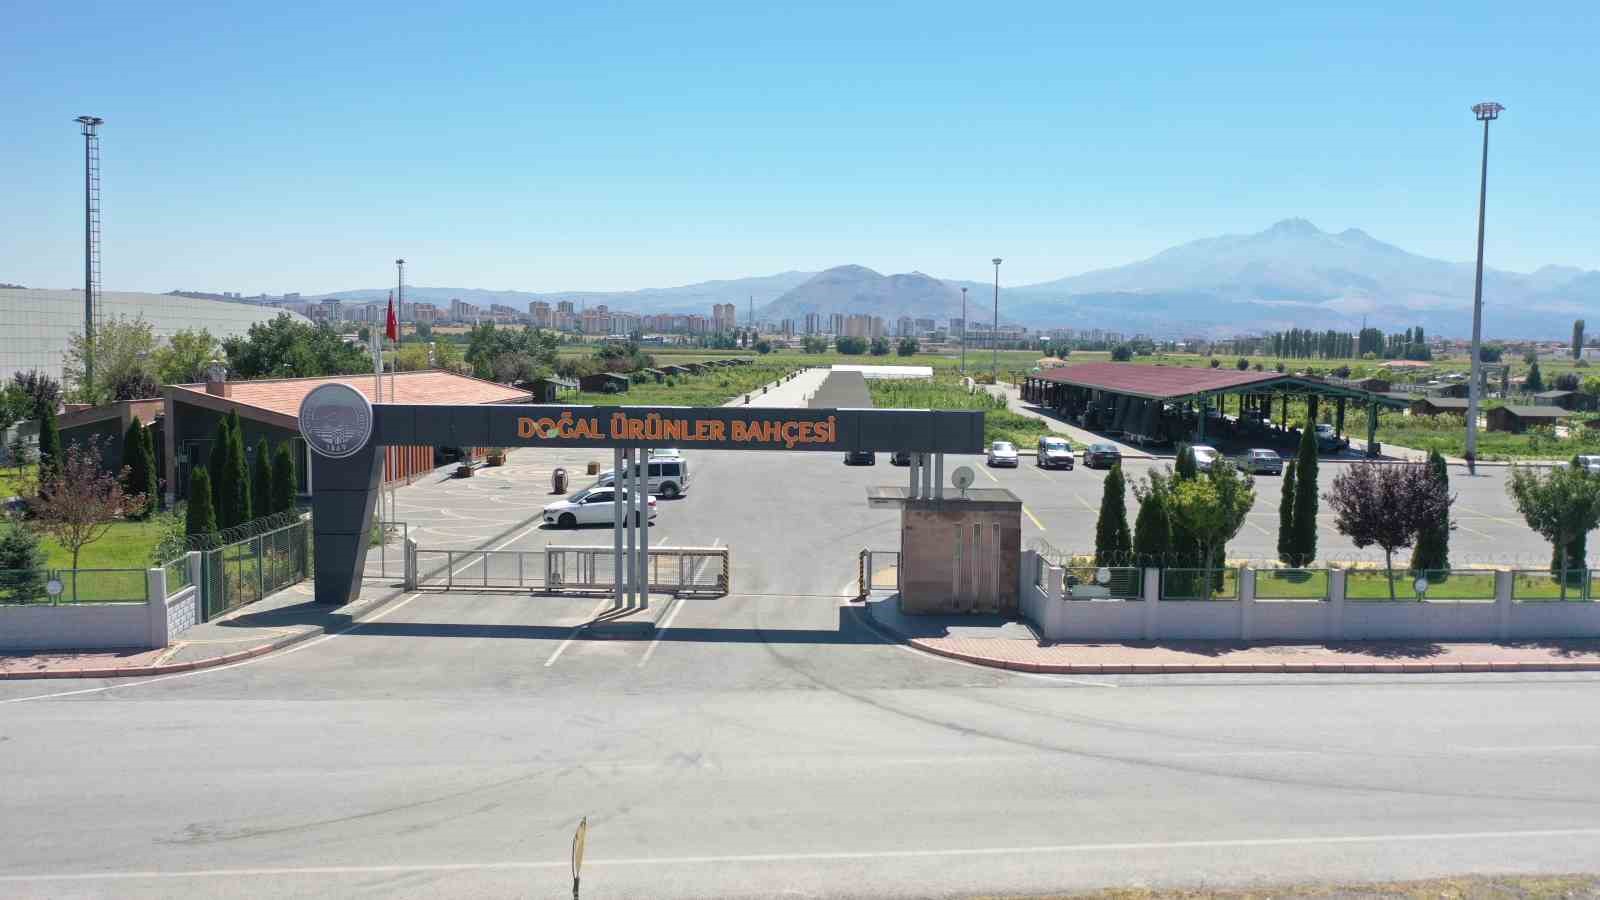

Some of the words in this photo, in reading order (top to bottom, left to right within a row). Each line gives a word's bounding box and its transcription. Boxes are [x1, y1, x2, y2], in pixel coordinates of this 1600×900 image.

[517, 411, 605, 440] DOĞAL
[610, 412, 725, 441] ÜRÜNLER
[731, 415, 836, 447] BAHÇESİ
